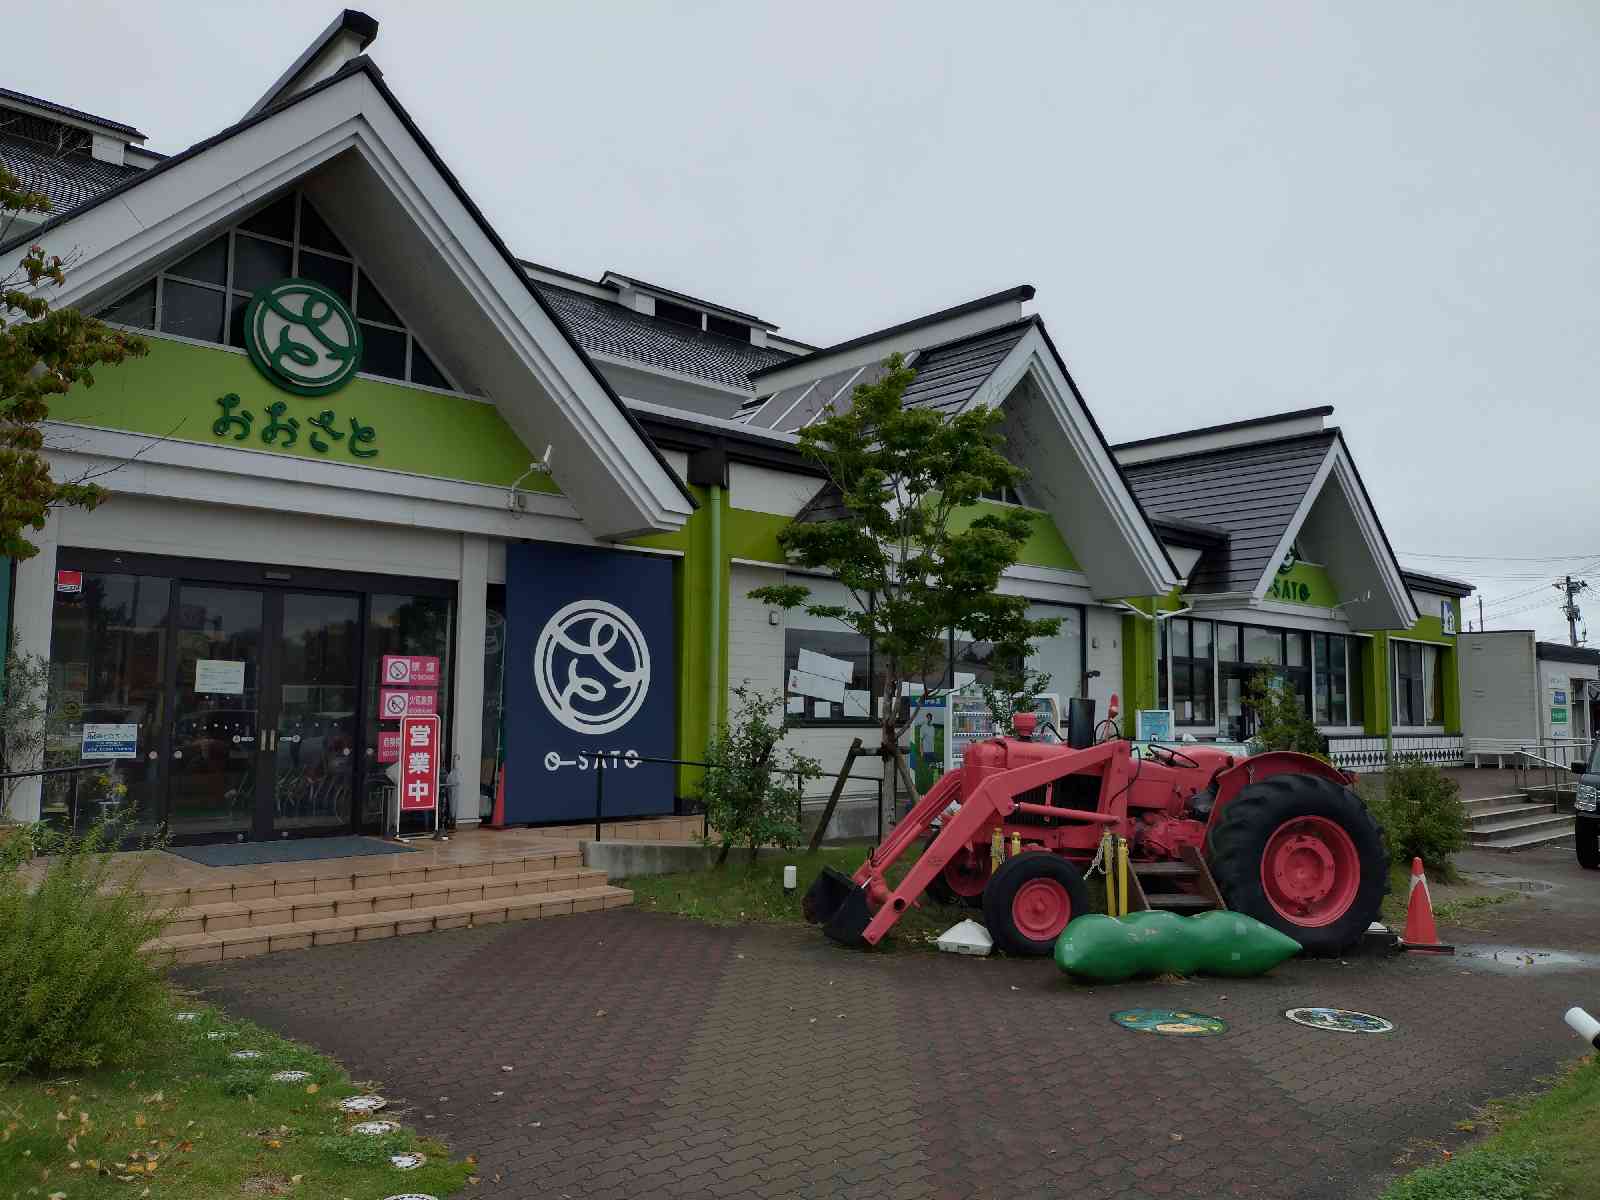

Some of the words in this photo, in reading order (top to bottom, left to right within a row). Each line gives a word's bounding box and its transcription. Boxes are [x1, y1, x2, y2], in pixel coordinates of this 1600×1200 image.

[213, 393, 379, 458] おおさと
[408, 725, 431, 802] 営業中
